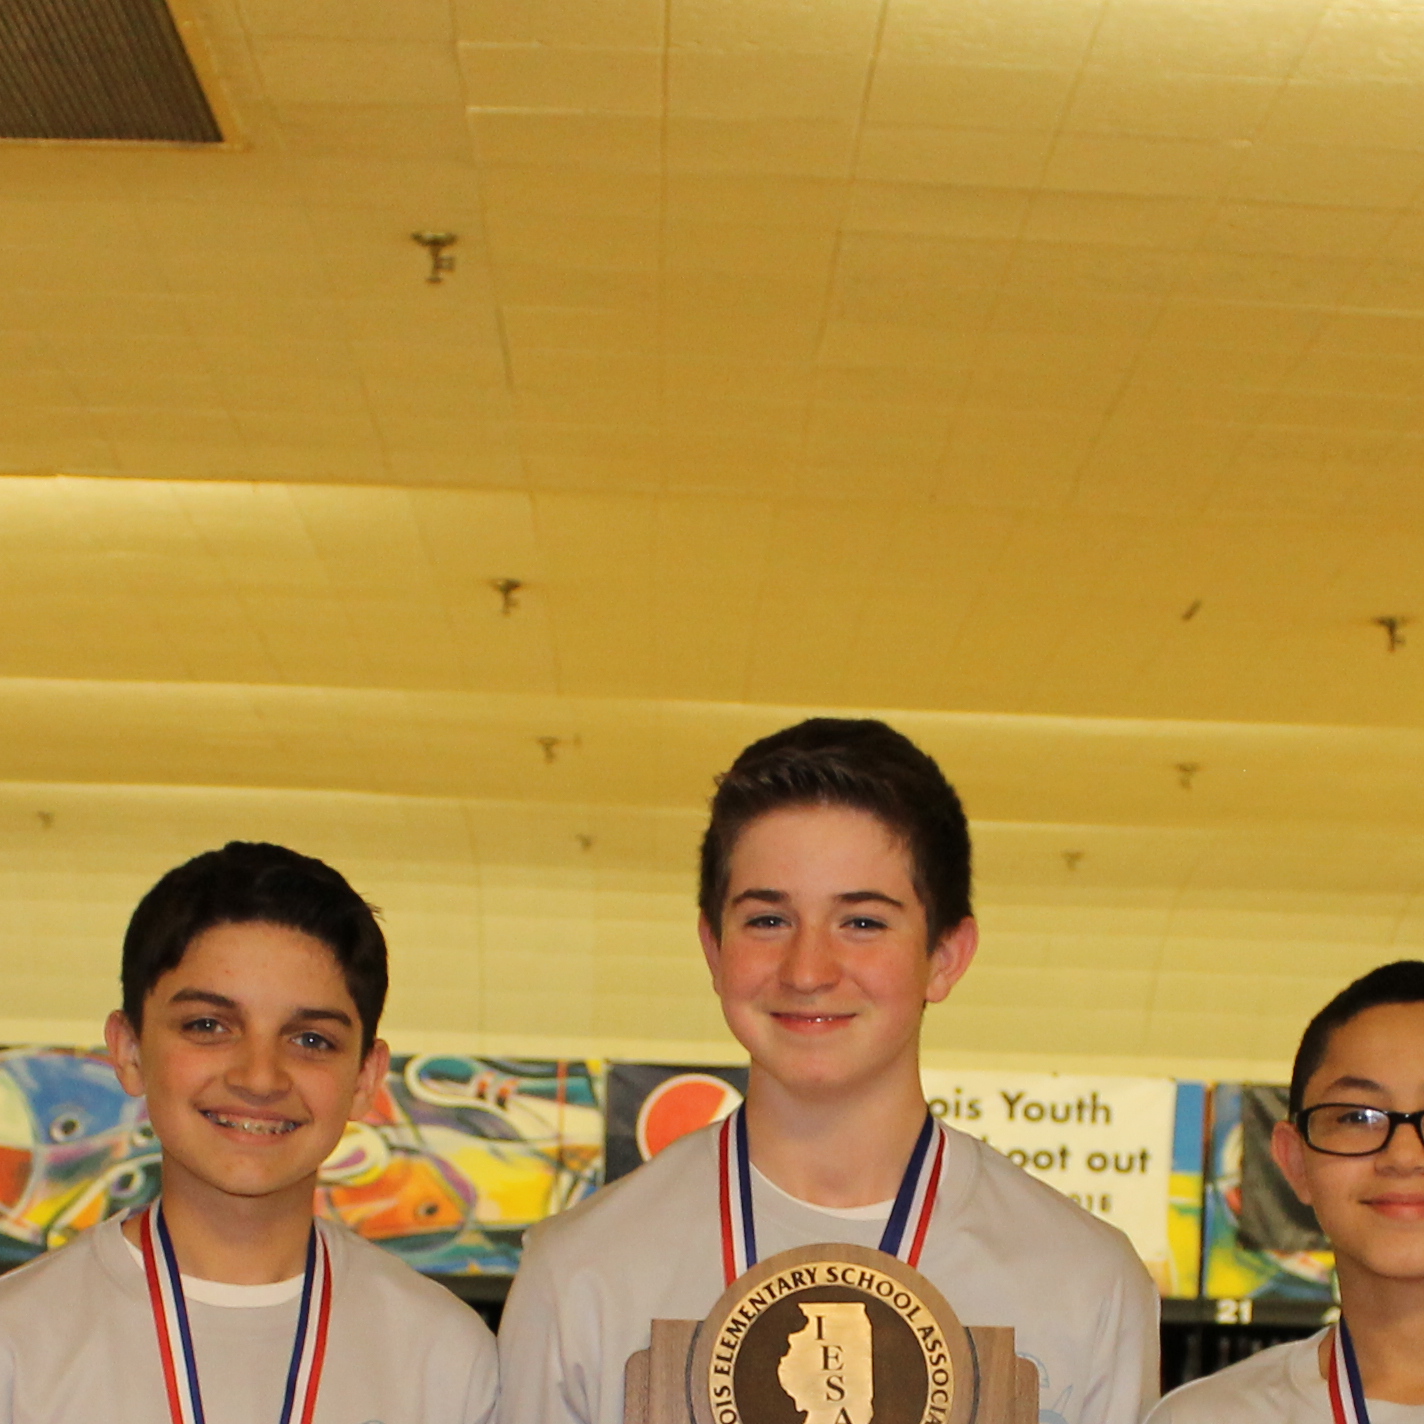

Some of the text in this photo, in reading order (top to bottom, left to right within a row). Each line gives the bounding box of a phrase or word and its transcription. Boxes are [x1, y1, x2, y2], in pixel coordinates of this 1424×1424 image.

[928, 1088, 1112, 1124] ois Youth
[1086, 1148, 1150, 1173] out
[715, 1266, 817, 1376] ELEMENTARY
[826, 1266, 920, 1322] SCHOOL
[1216, 1299, 1252, 1324] 21
